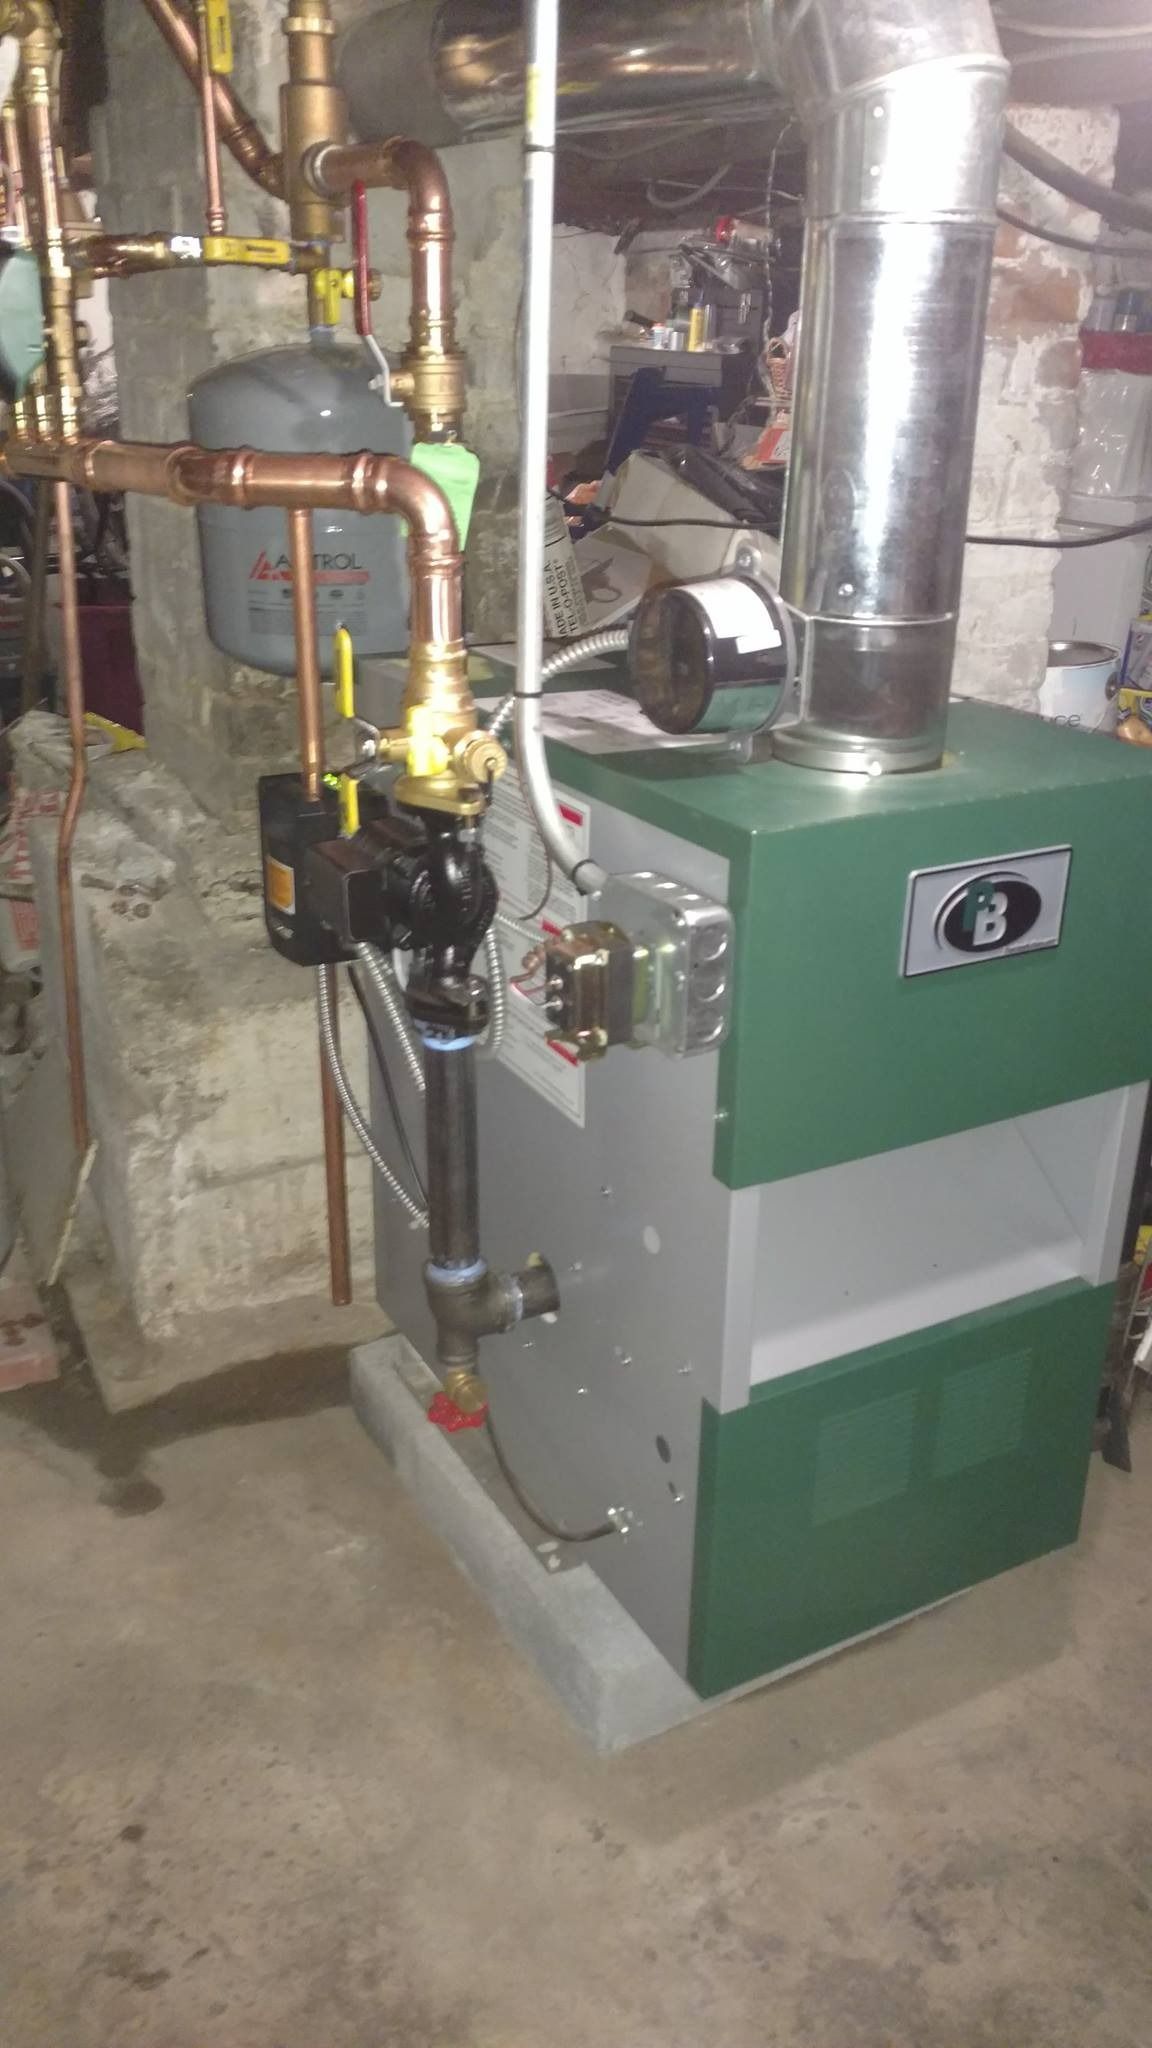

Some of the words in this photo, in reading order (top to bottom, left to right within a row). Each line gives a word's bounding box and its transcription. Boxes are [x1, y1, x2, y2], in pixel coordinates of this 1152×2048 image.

[275, 553, 362, 570] ATROL
[550, 597, 561, 610] IN
[962, 880, 1008, 946] PB
